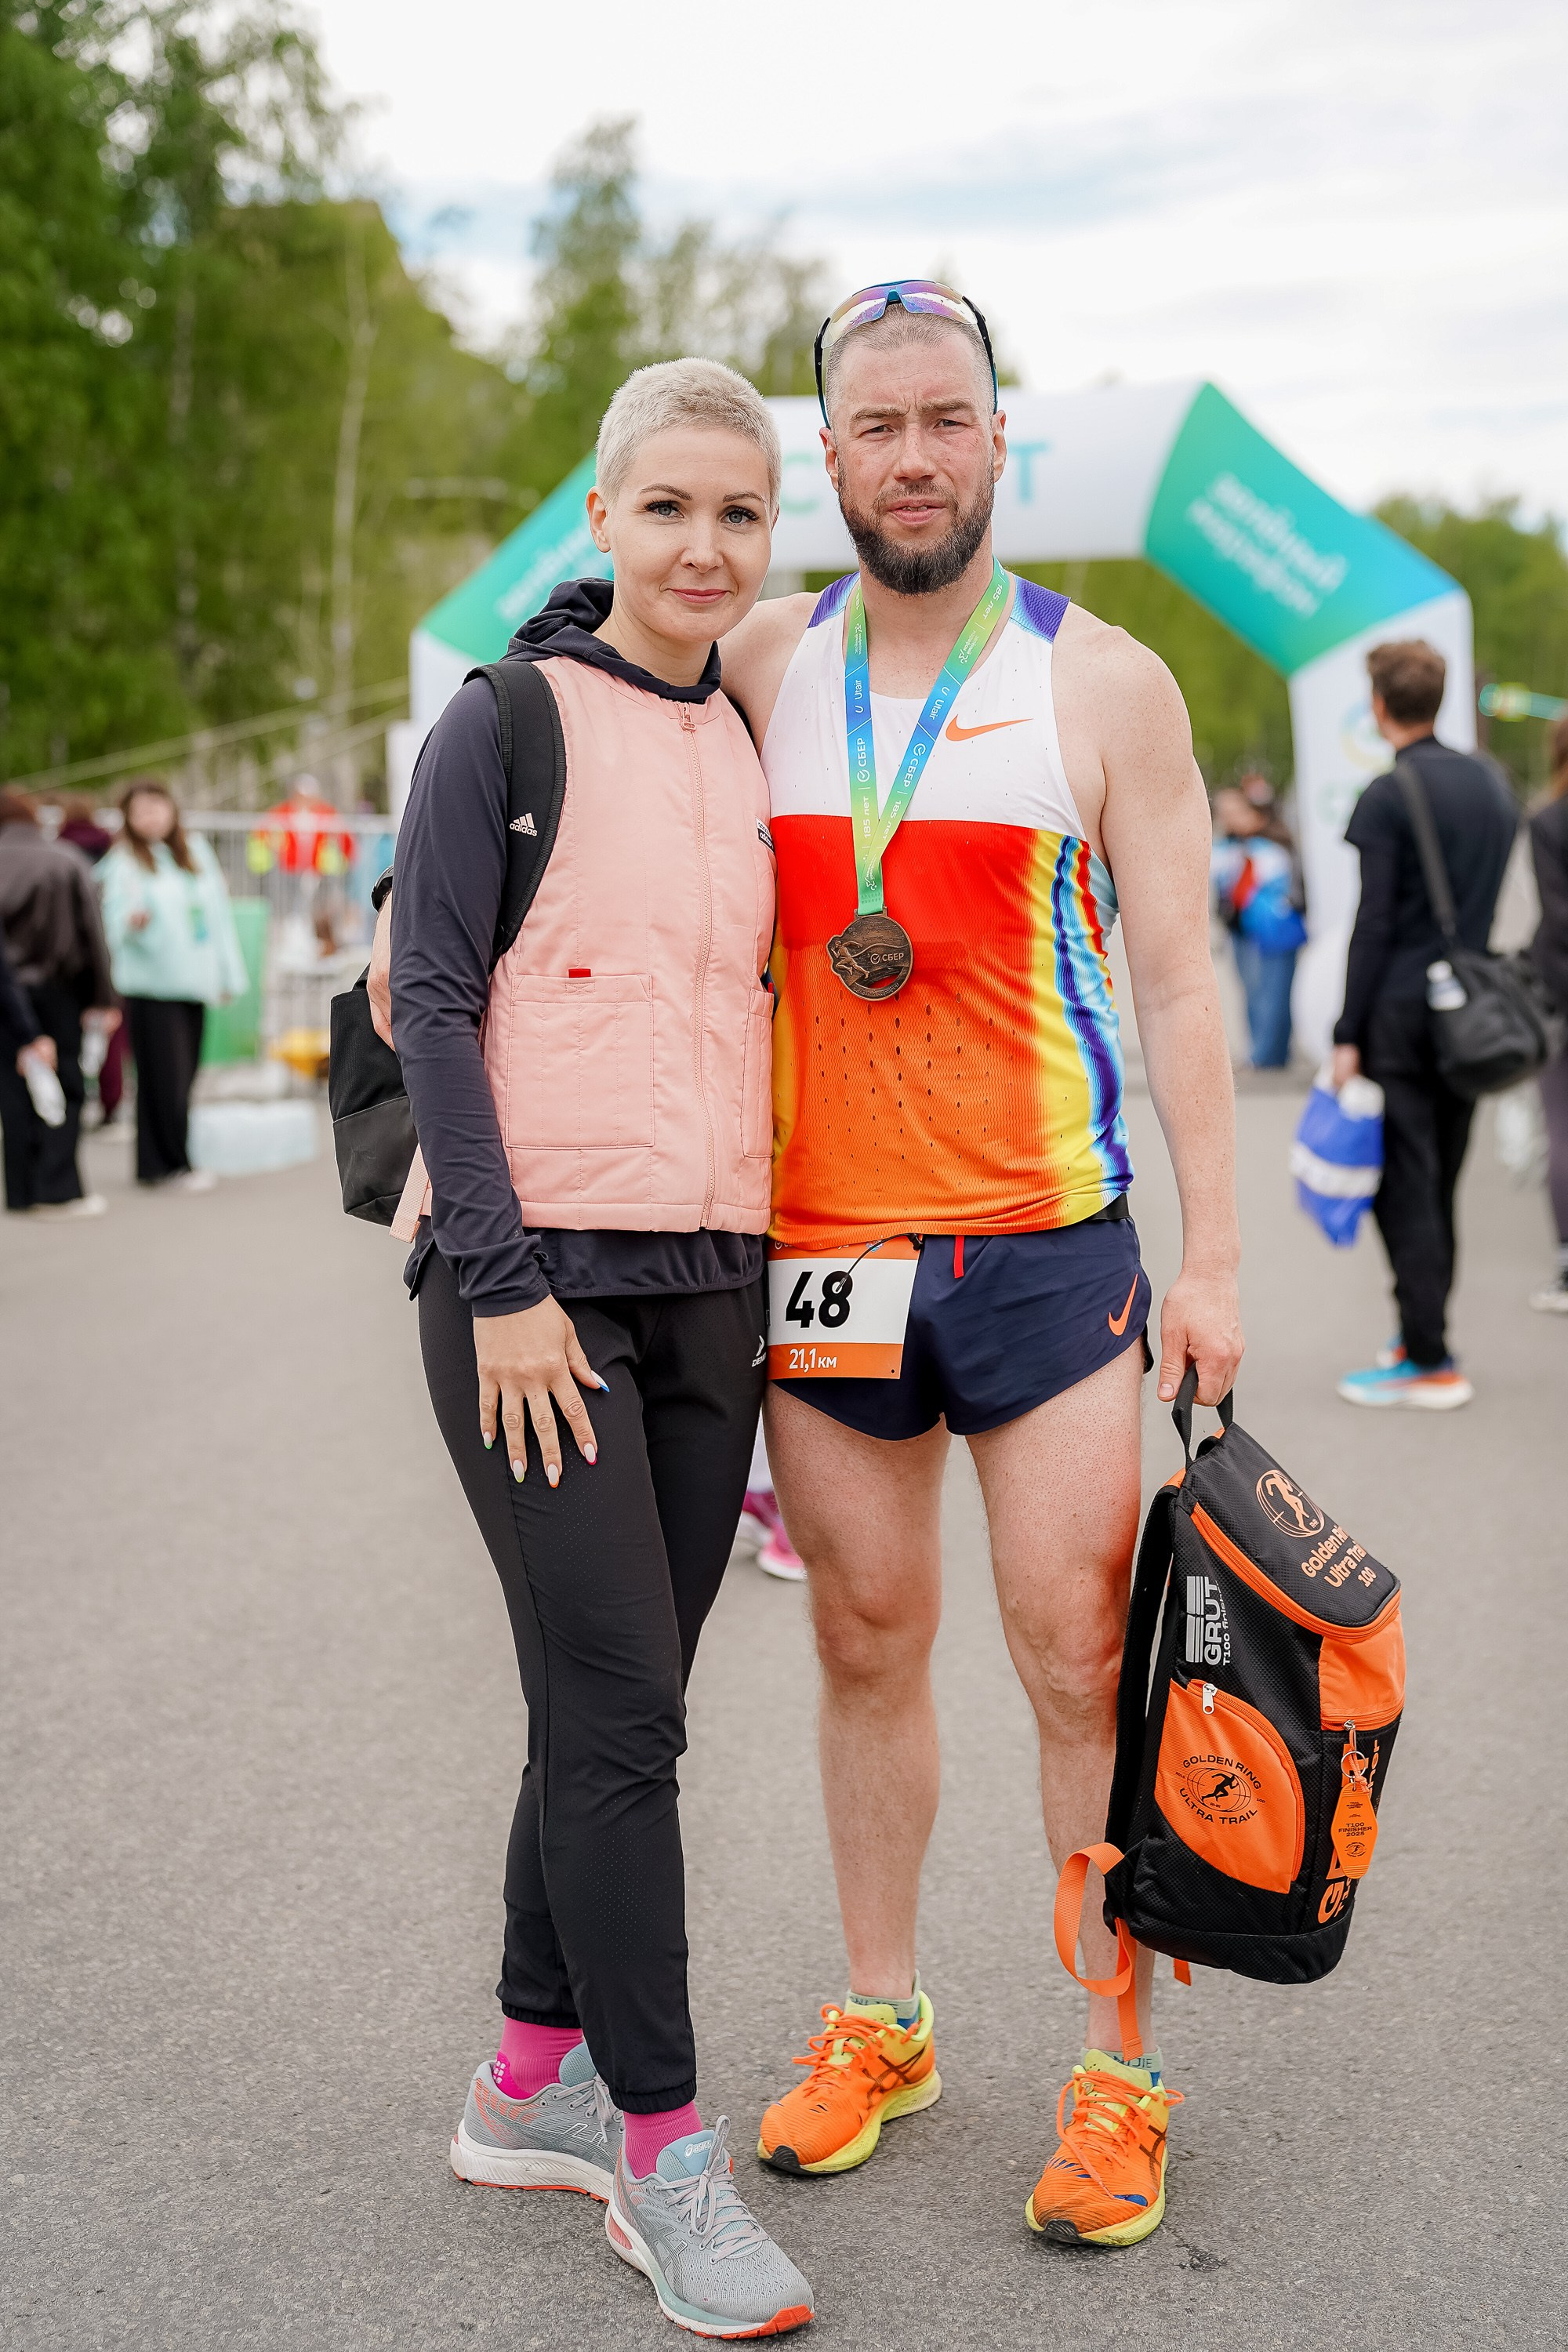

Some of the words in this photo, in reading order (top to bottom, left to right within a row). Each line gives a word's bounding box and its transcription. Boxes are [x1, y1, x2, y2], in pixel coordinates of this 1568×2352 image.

[854, 679, 863, 700] Utair
[928, 699, 945, 720] Utair
[856, 737, 867, 768] СБЕР
[903, 757, 919, 788] СБЕР
[890, 799, 902, 819] 185
[509, 822, 538, 837] adidas
[882, 820, 892, 841] лет
[882, 953, 904, 962] СБЕР
[785, 1270, 854, 1329] 48
[1301, 1535, 1340, 1578] Golden
[1323, 1555, 1358, 1588] Ultra
[1357, 1566, 1377, 1588] 100
[1203, 1576, 1222, 1666] GRUT
[1222, 1632, 1231, 1666] T100
[1182, 1755, 1234, 1769] GOLDEN
[1235, 1762, 1261, 1790] RING
[1179, 1788, 1214, 1823] ULTRA
[1218, 1809, 1258, 1825] TRAIL
